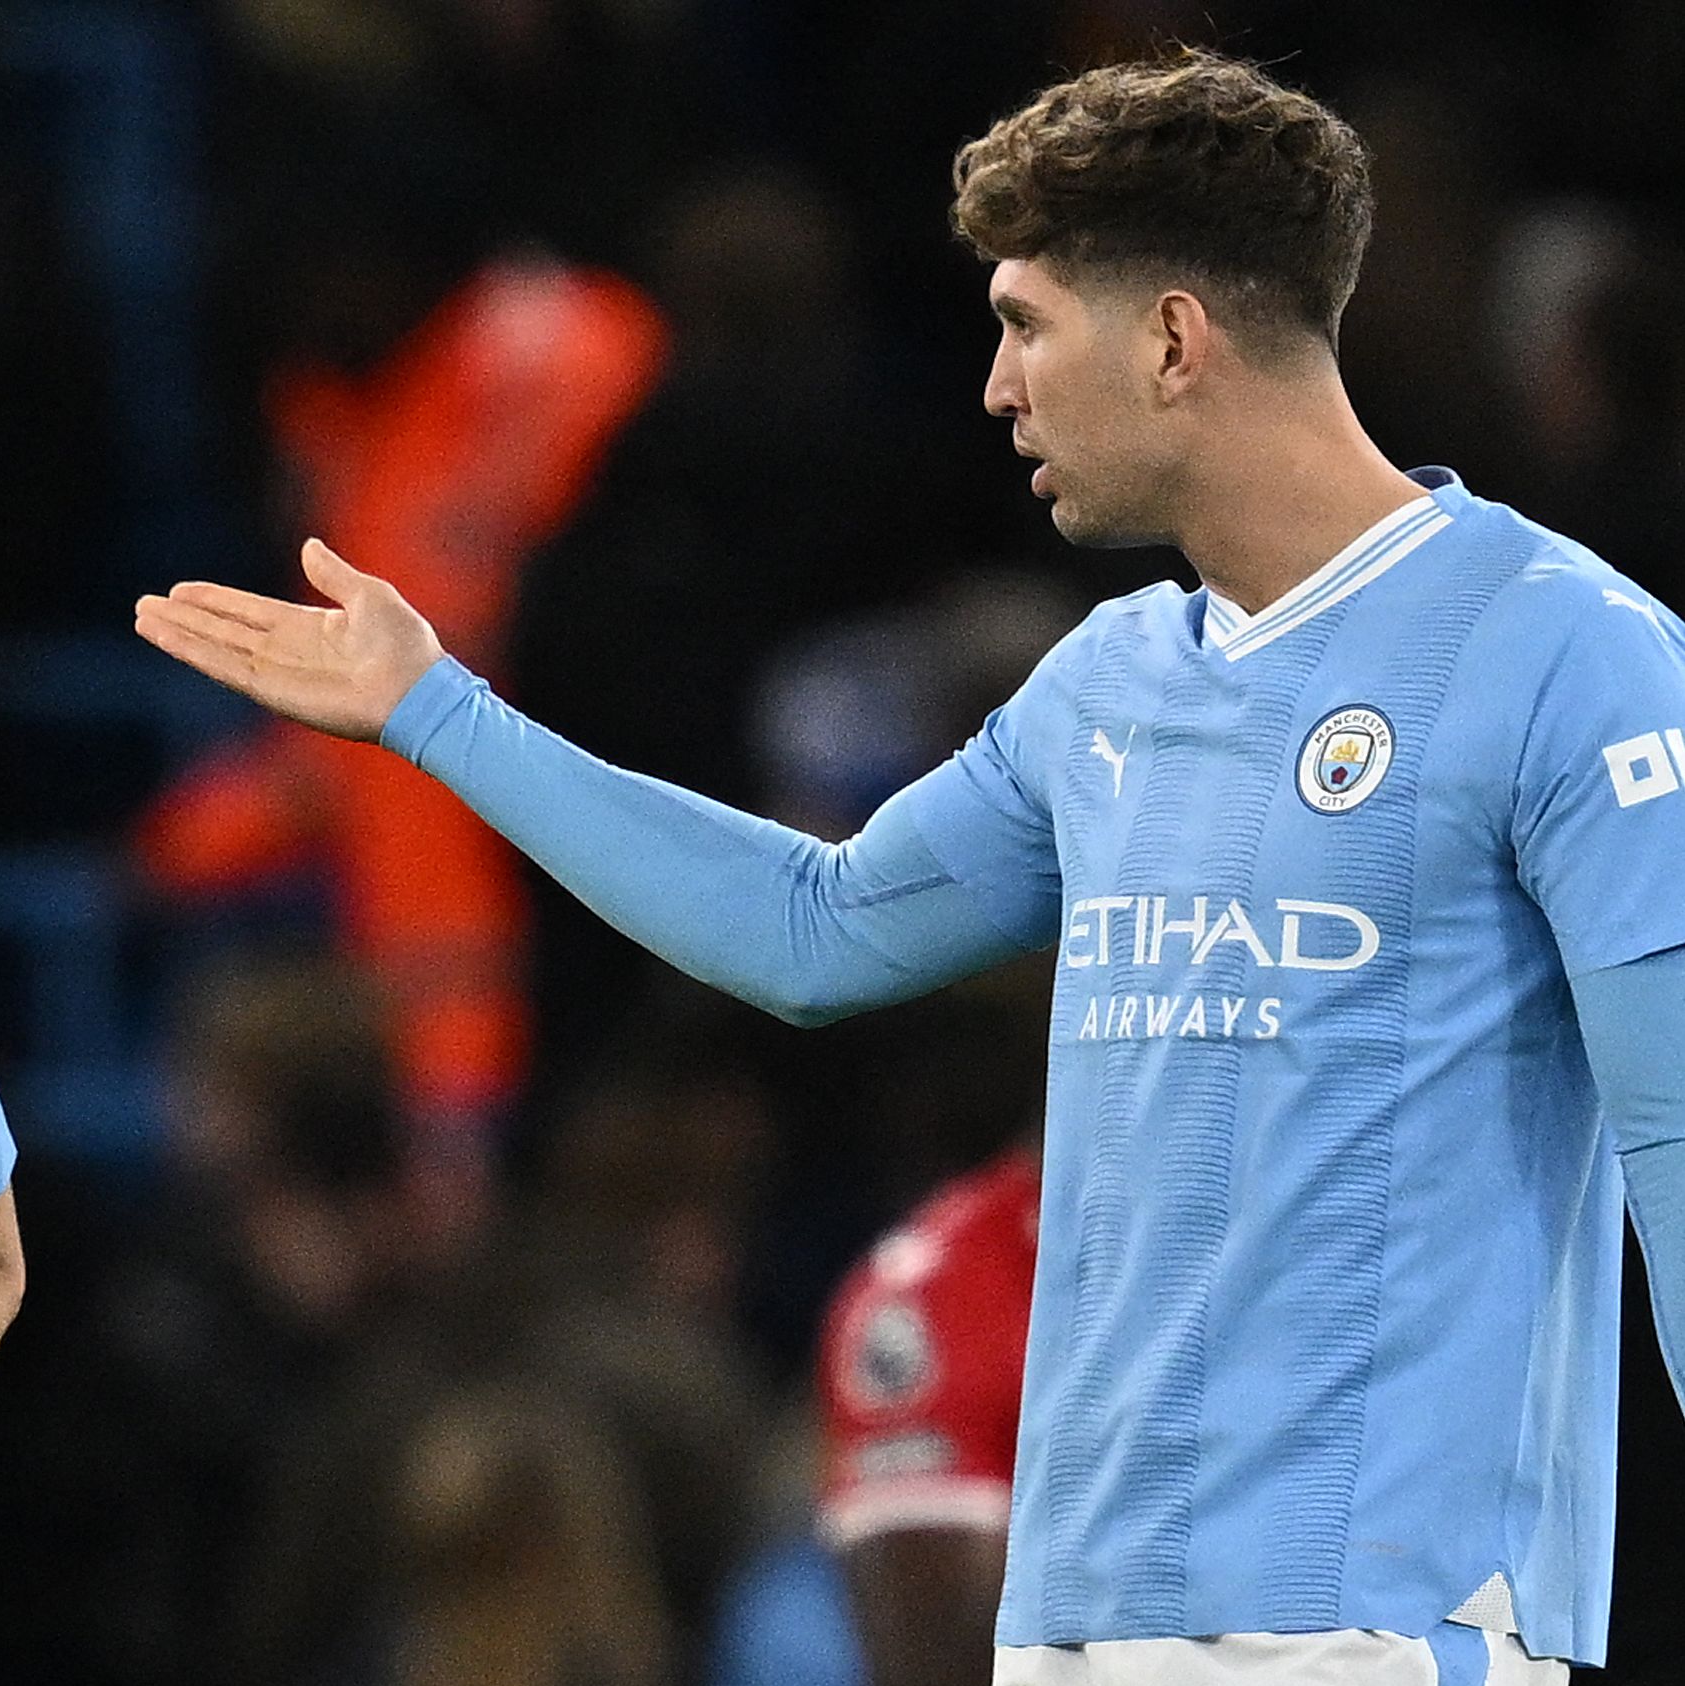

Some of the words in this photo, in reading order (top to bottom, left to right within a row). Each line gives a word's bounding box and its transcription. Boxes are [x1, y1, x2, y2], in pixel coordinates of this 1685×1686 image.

[1315, 712, 1388, 748] MANCHESTER
[1318, 795, 1347, 807] CITY
[1066, 896, 1380, 971] ETIHAD
[1078, 995, 1282, 1041] AIRWAYS
